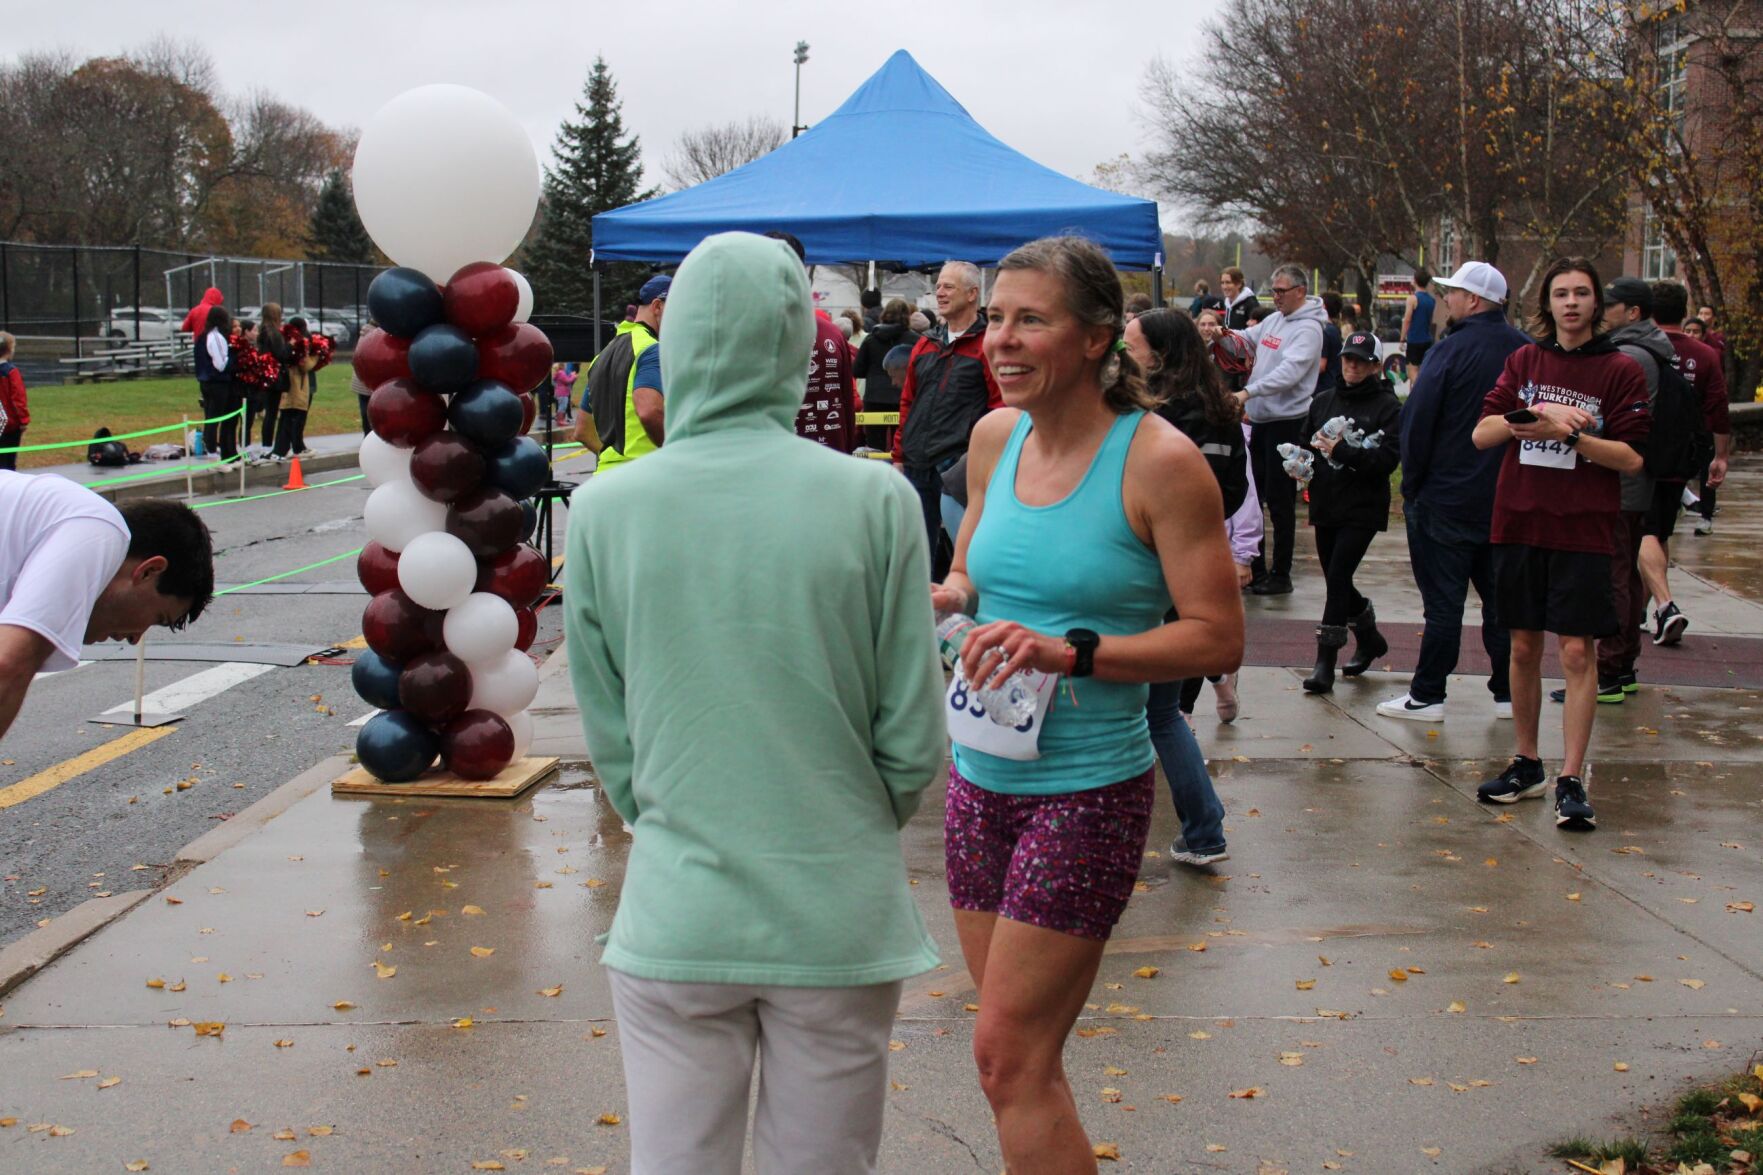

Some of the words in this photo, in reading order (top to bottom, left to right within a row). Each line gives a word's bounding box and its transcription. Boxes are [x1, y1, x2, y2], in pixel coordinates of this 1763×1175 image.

[1538, 391, 1574, 404] TURKEY
[1575, 400, 1600, 413] TROT
[1540, 384, 1602, 405] WESTBOROUGH
